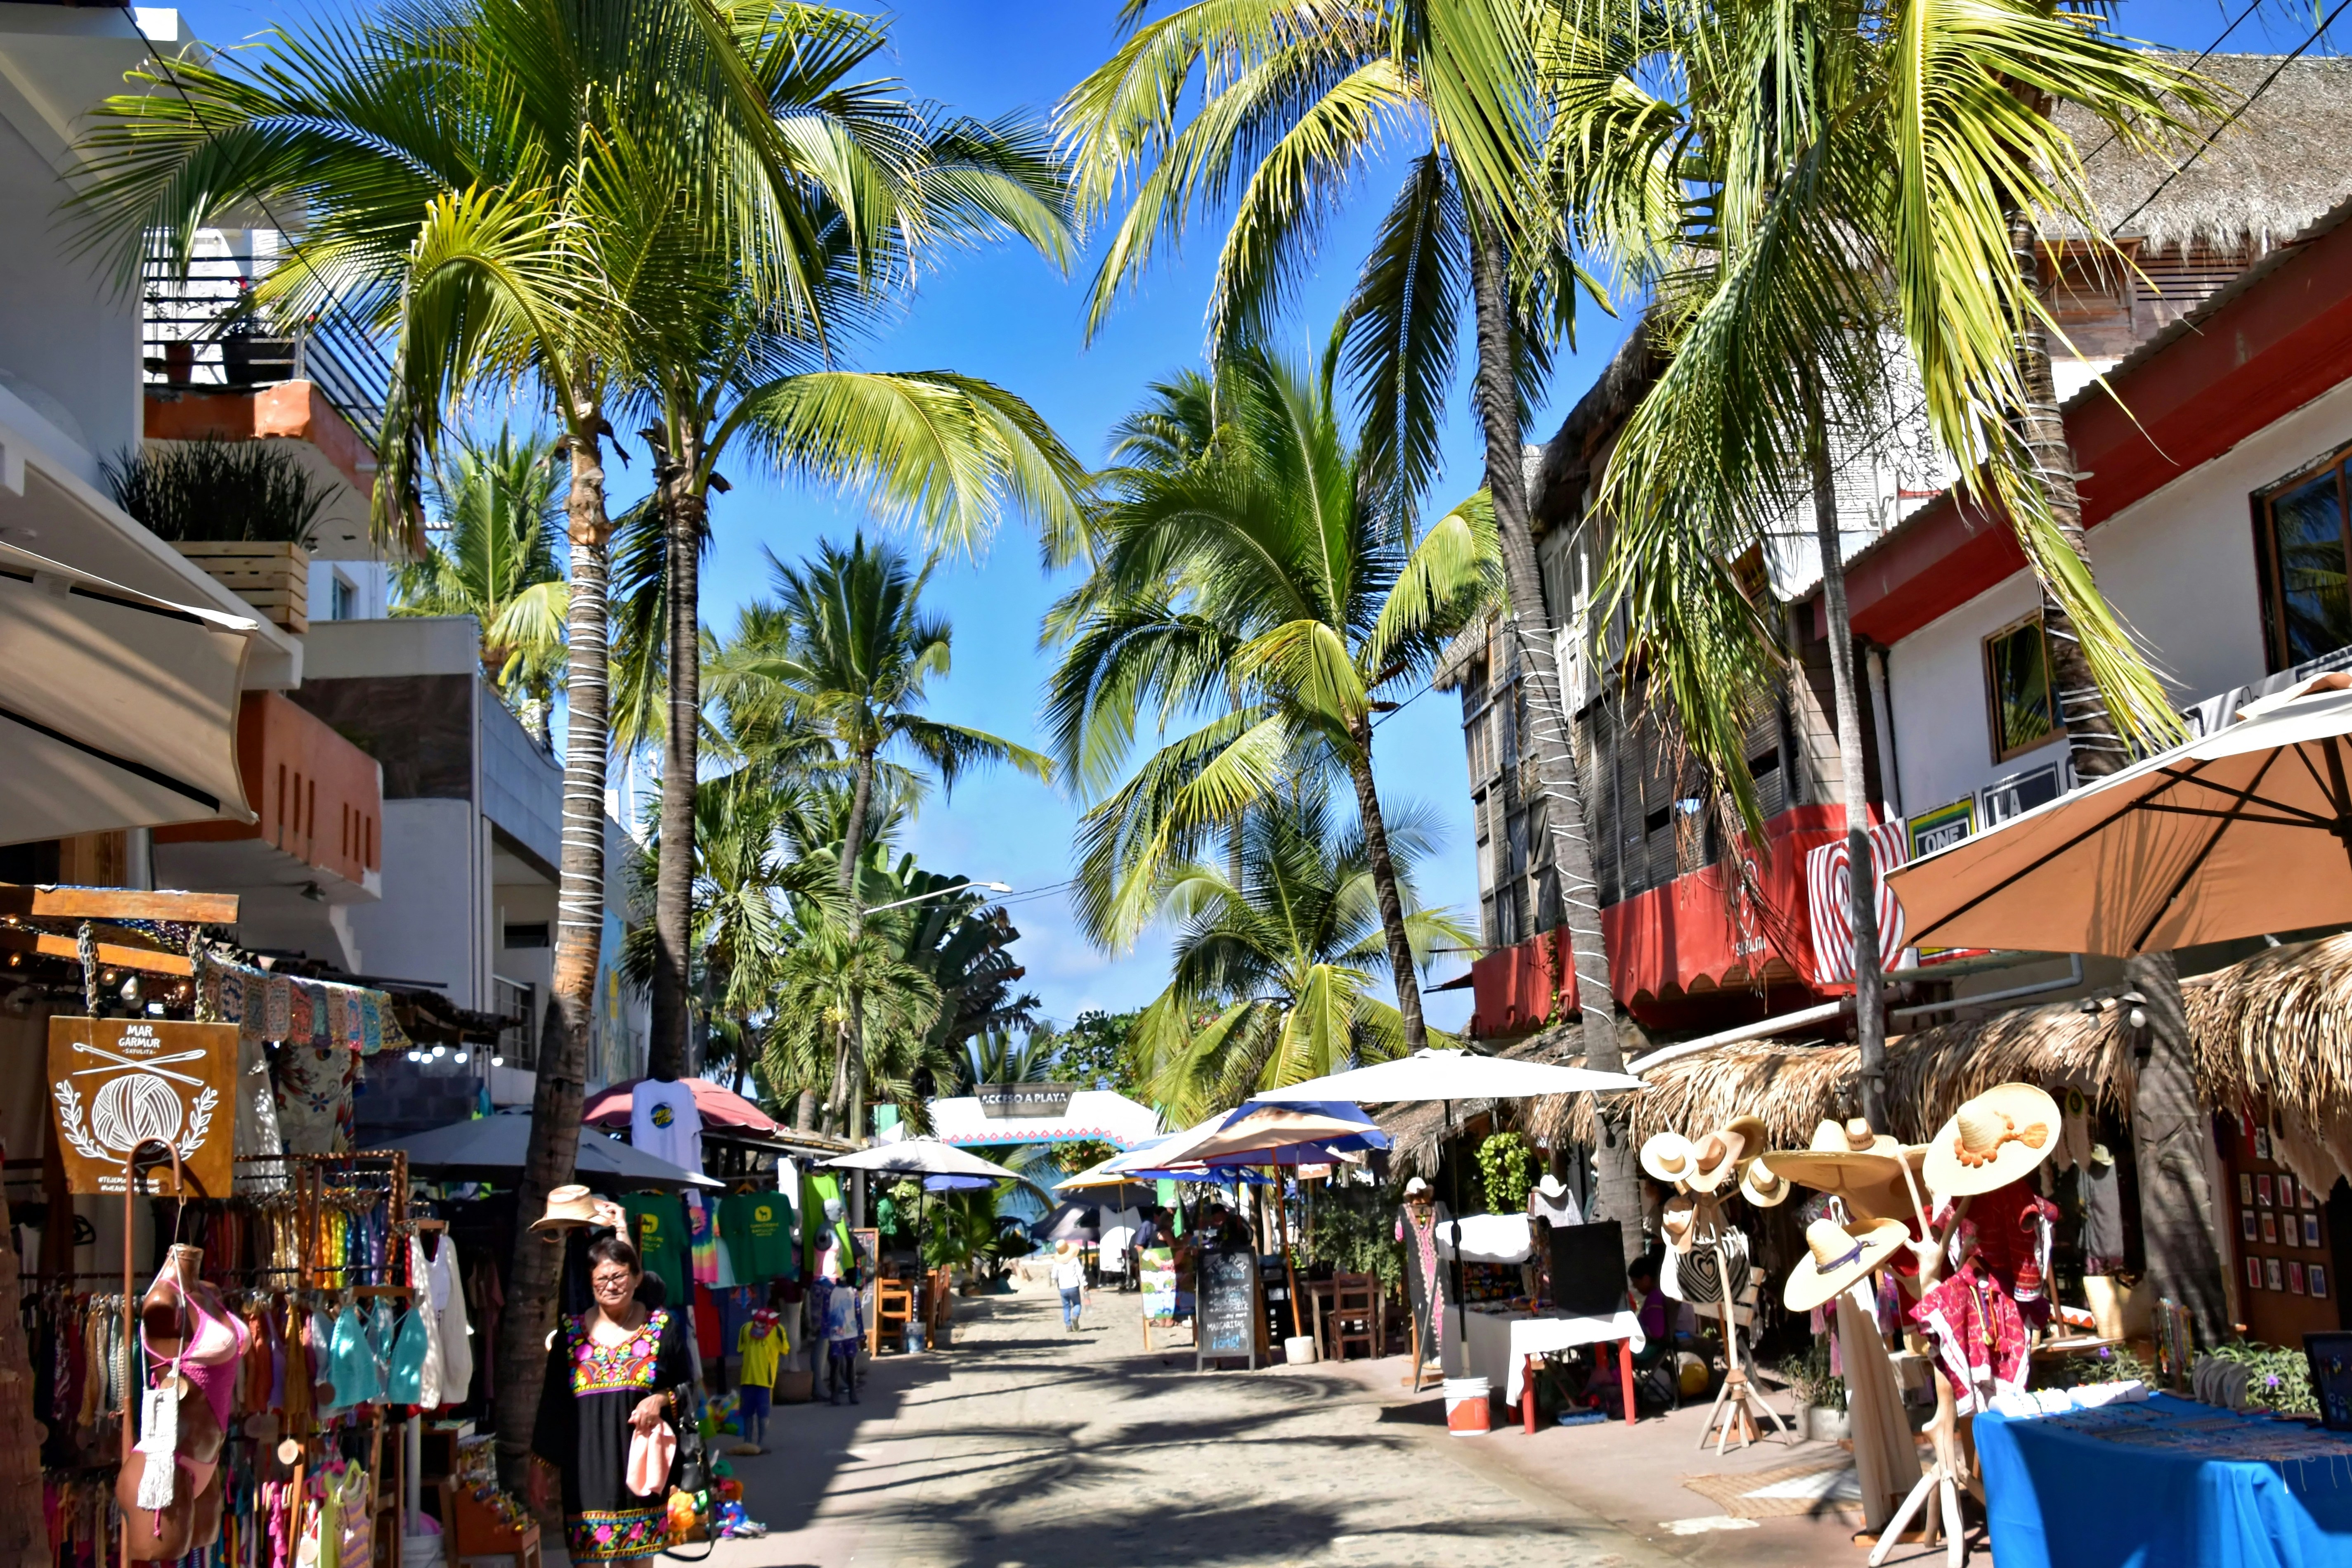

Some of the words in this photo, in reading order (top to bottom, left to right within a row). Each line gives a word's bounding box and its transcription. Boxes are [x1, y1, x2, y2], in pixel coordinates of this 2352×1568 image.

[127, 1025, 153, 1037] MAR
[118, 1037, 161, 1048] GARMUR
[981, 1094, 1023, 1104] ACCESO
[1025, 1094, 1033, 1103] A
[1034, 1093, 1067, 1103] PLAYA
